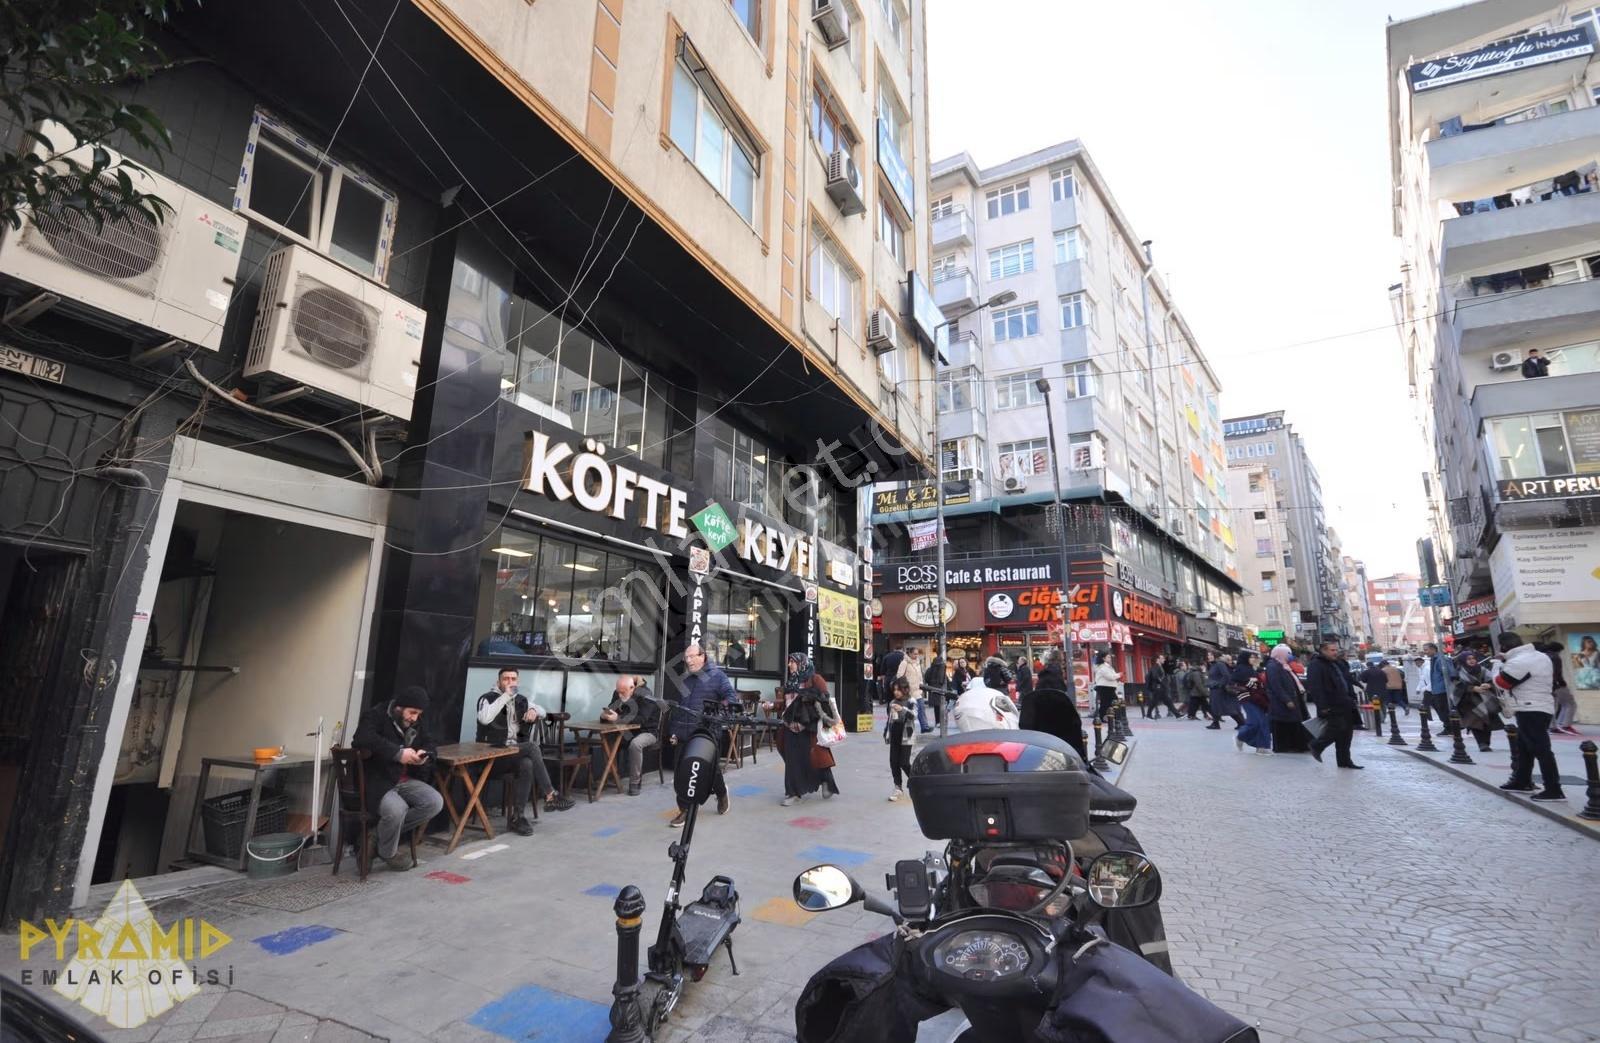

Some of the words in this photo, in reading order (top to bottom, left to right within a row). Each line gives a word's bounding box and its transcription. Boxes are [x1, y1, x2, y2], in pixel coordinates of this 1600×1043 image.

[526, 430, 688, 539] KÖFTE
[1503, 481, 1550, 497] ART
[876, 491, 898, 506] Mi
[906, 488, 918, 502] &
[879, 502, 909, 513] Güzellik
[704, 513, 731, 535] Köfte
[743, 518, 815, 581] KEYFİ
[897, 565, 938, 584] BOSS
[945, 569, 970, 584] Cafe
[973, 570, 982, 583] &
[985, 564, 1052, 582] Restaurant
[905, 583, 932, 591] LOUNGE
[690, 573, 704, 647] YAPRAK
